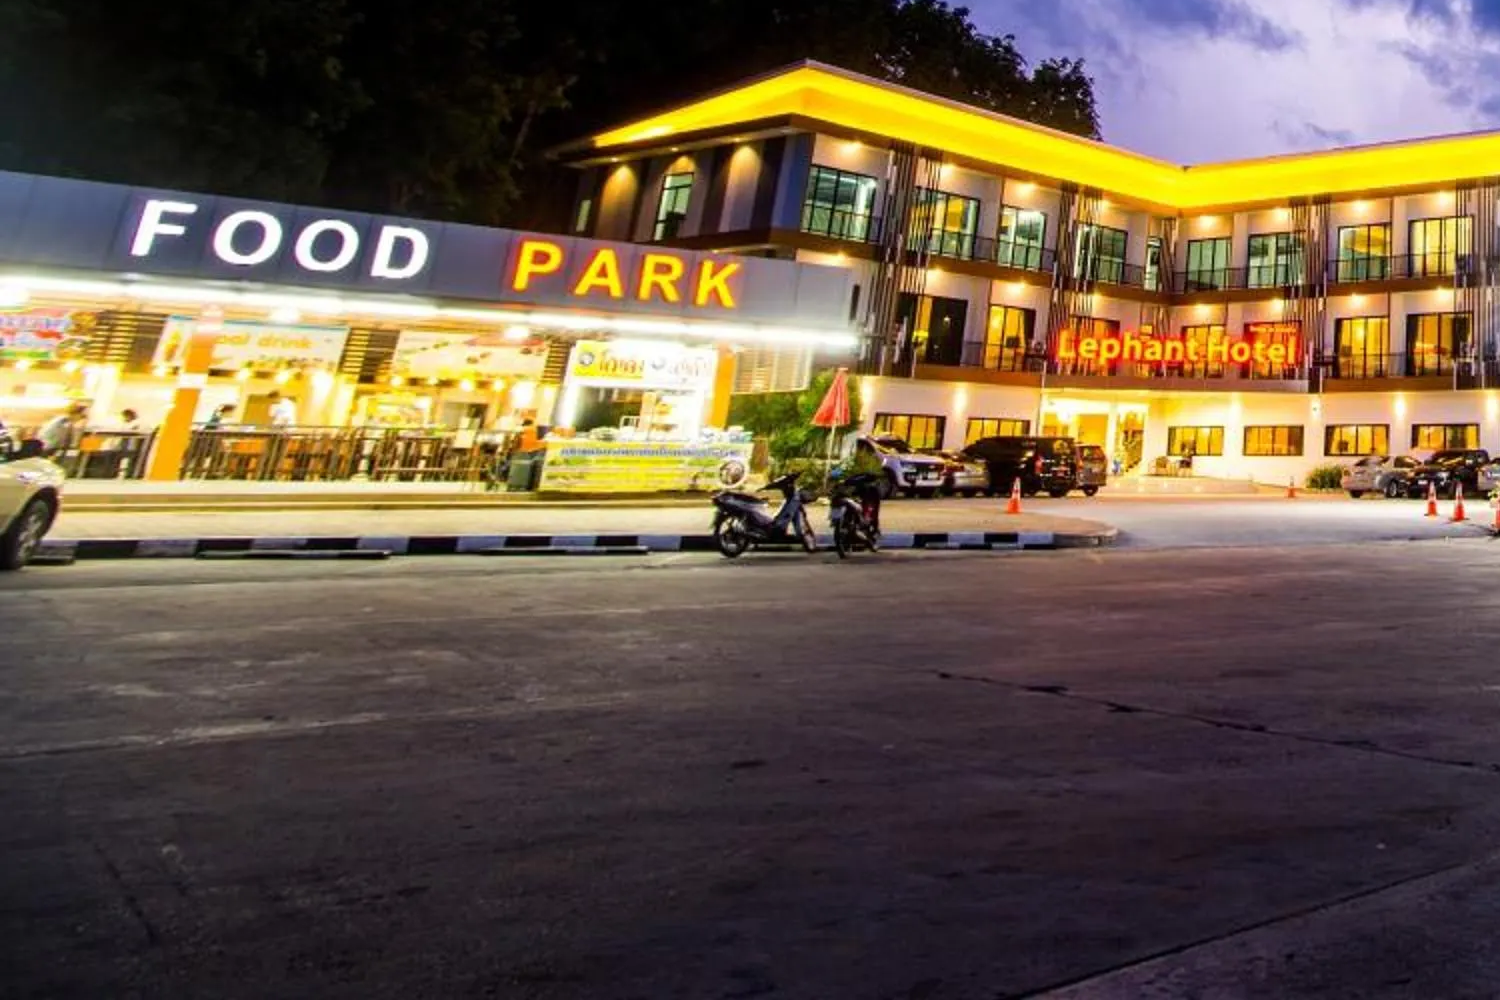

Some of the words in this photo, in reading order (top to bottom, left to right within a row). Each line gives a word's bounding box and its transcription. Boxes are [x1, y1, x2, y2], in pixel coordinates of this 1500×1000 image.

[129, 199, 430, 279] FOOD
[511, 240, 741, 309] PARK
[1057, 328, 1201, 364] Lephant
[1206, 334, 1298, 365] Hotel
